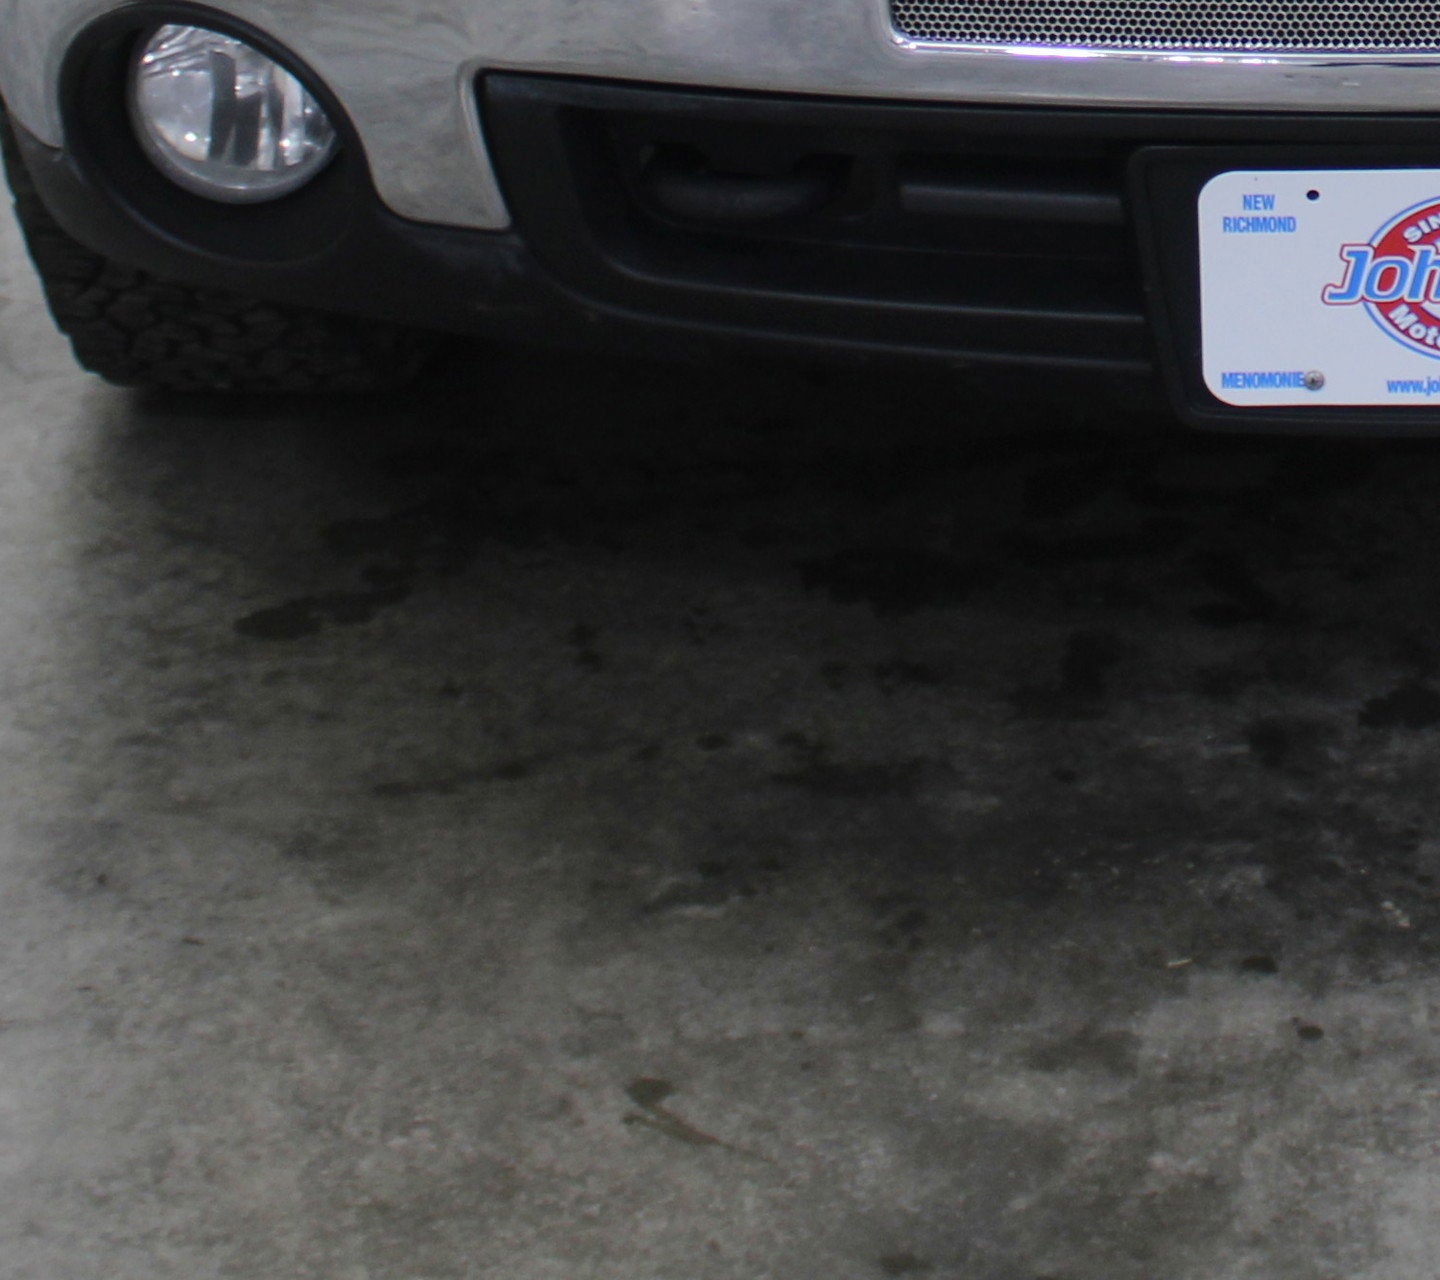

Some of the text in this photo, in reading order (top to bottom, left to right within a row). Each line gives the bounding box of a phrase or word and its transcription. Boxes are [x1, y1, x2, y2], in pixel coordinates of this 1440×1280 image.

[1242, 194, 1275, 211] NEW
[1222, 216, 1297, 233] RICHMOND
[1221, 371, 1306, 388] MENOMONIE
